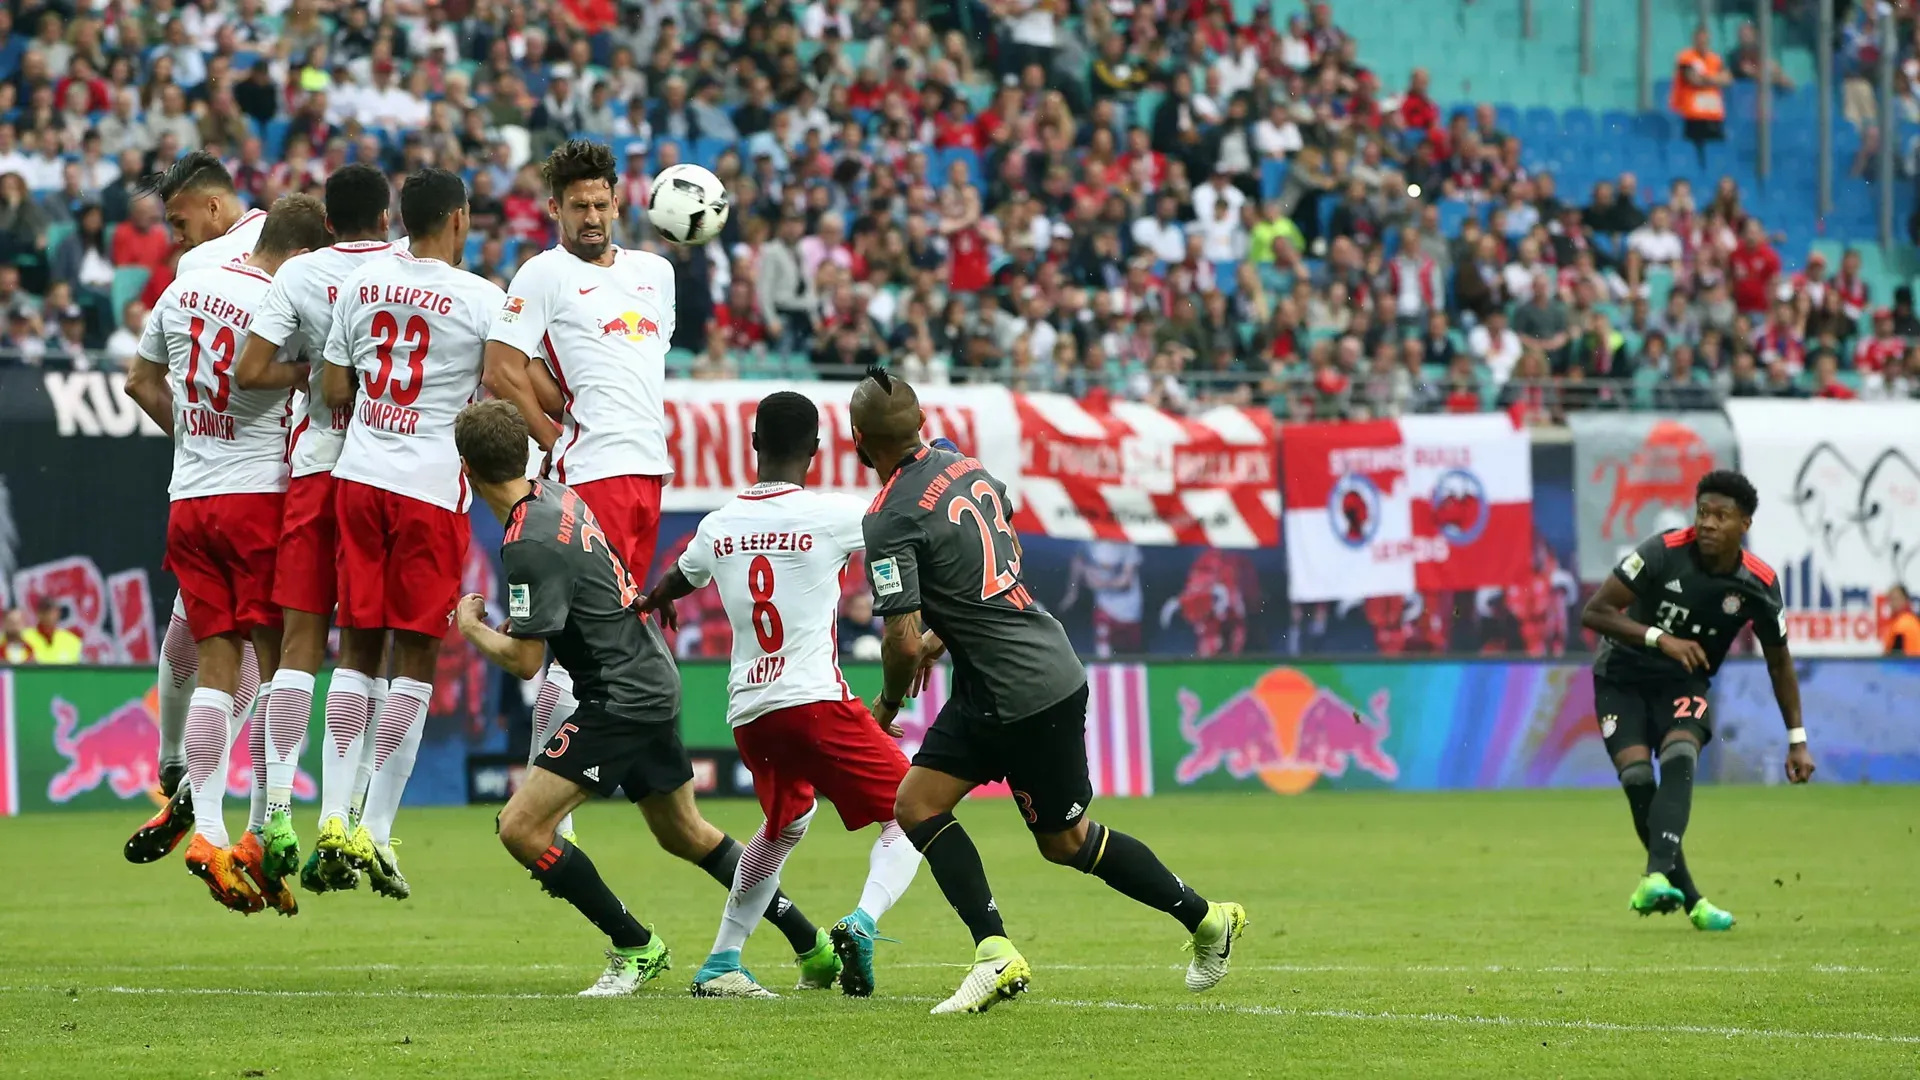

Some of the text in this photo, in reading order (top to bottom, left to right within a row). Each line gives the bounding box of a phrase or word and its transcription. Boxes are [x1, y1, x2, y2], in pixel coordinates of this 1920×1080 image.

[180, 291, 251, 330] RB LEIPZI
[327, 286, 338, 305] R
[359, 285, 453, 316] RB LEIPZIG
[185, 316, 236, 413] 13
[364, 310, 431, 408] 33
[917, 473, 951, 512] BAYERN
[713, 532, 814, 559] RB LEIPZIG
[947, 479, 1021, 601] 23
[748, 554, 785, 654] 8
[747, 656, 785, 684] KEITA
[1673, 696, 1708, 719] 27
[545, 722, 580, 758] 5
